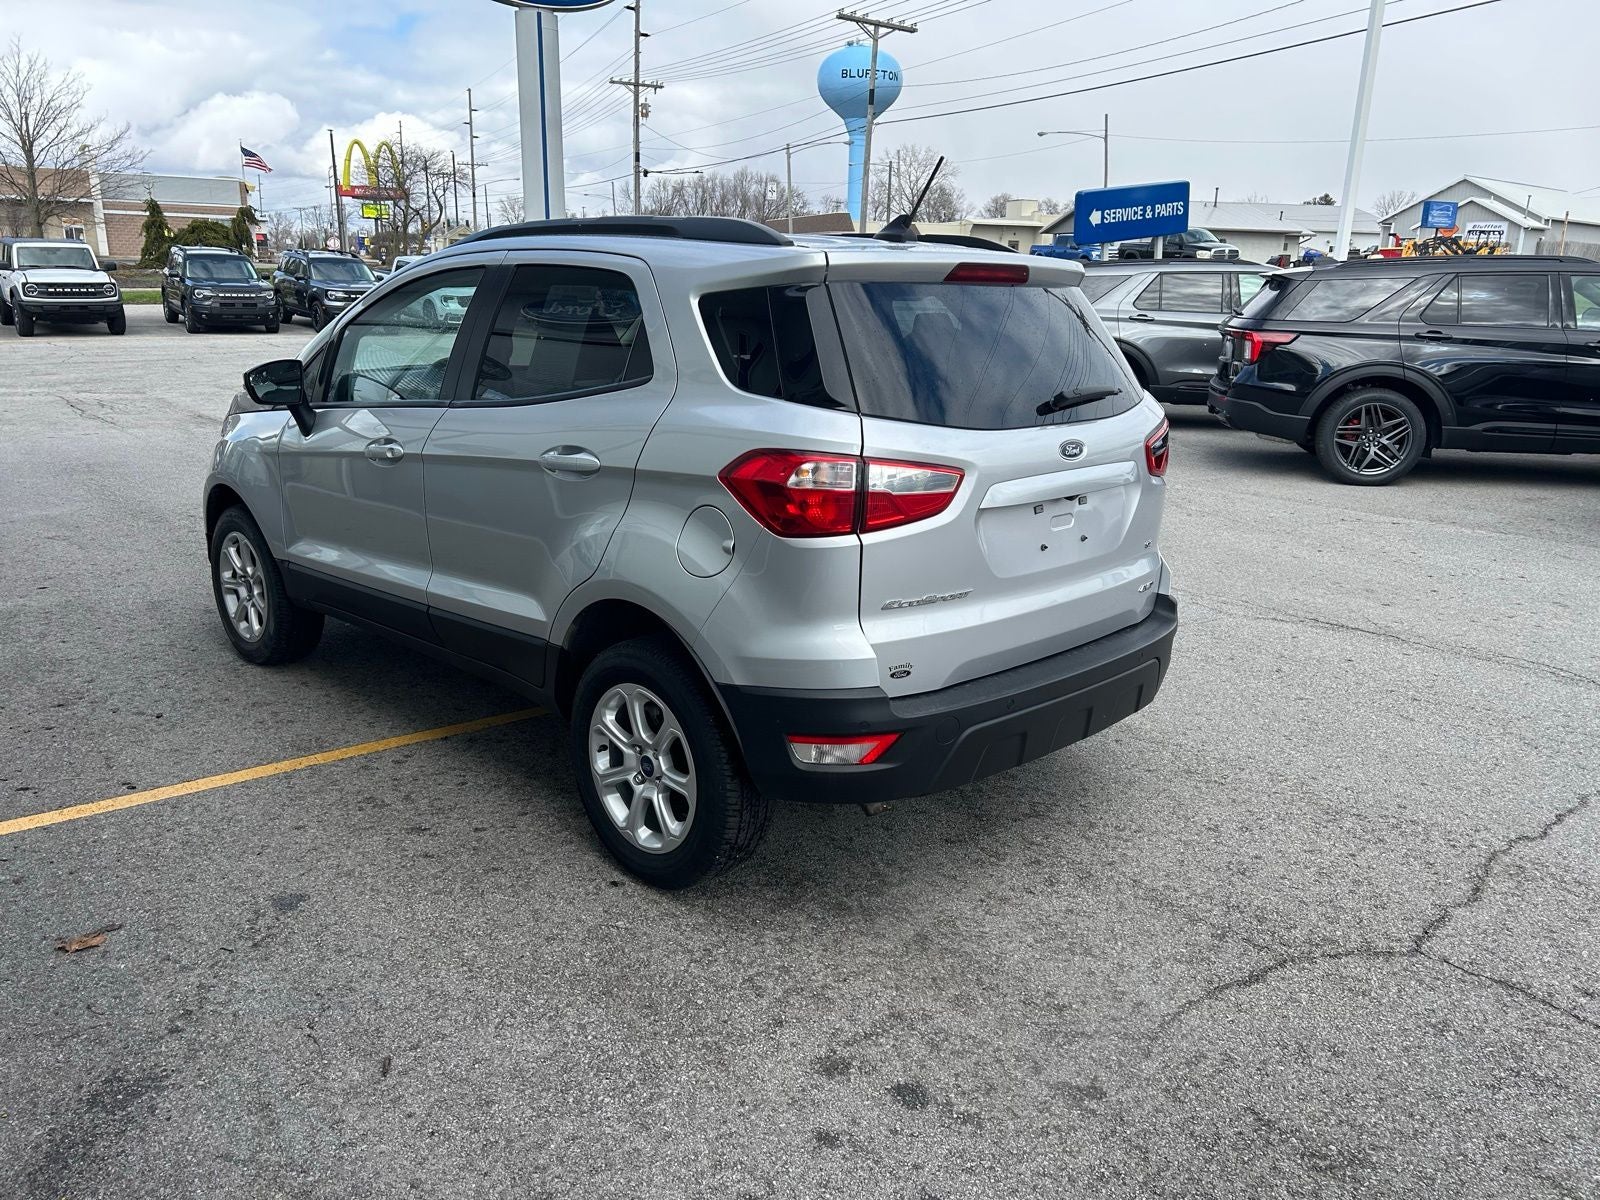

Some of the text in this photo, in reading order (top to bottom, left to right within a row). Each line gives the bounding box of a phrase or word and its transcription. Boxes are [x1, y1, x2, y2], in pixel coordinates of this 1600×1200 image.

[1103, 201, 1184, 224] SERVICE & PARTS
[888, 662, 913, 672] Family
